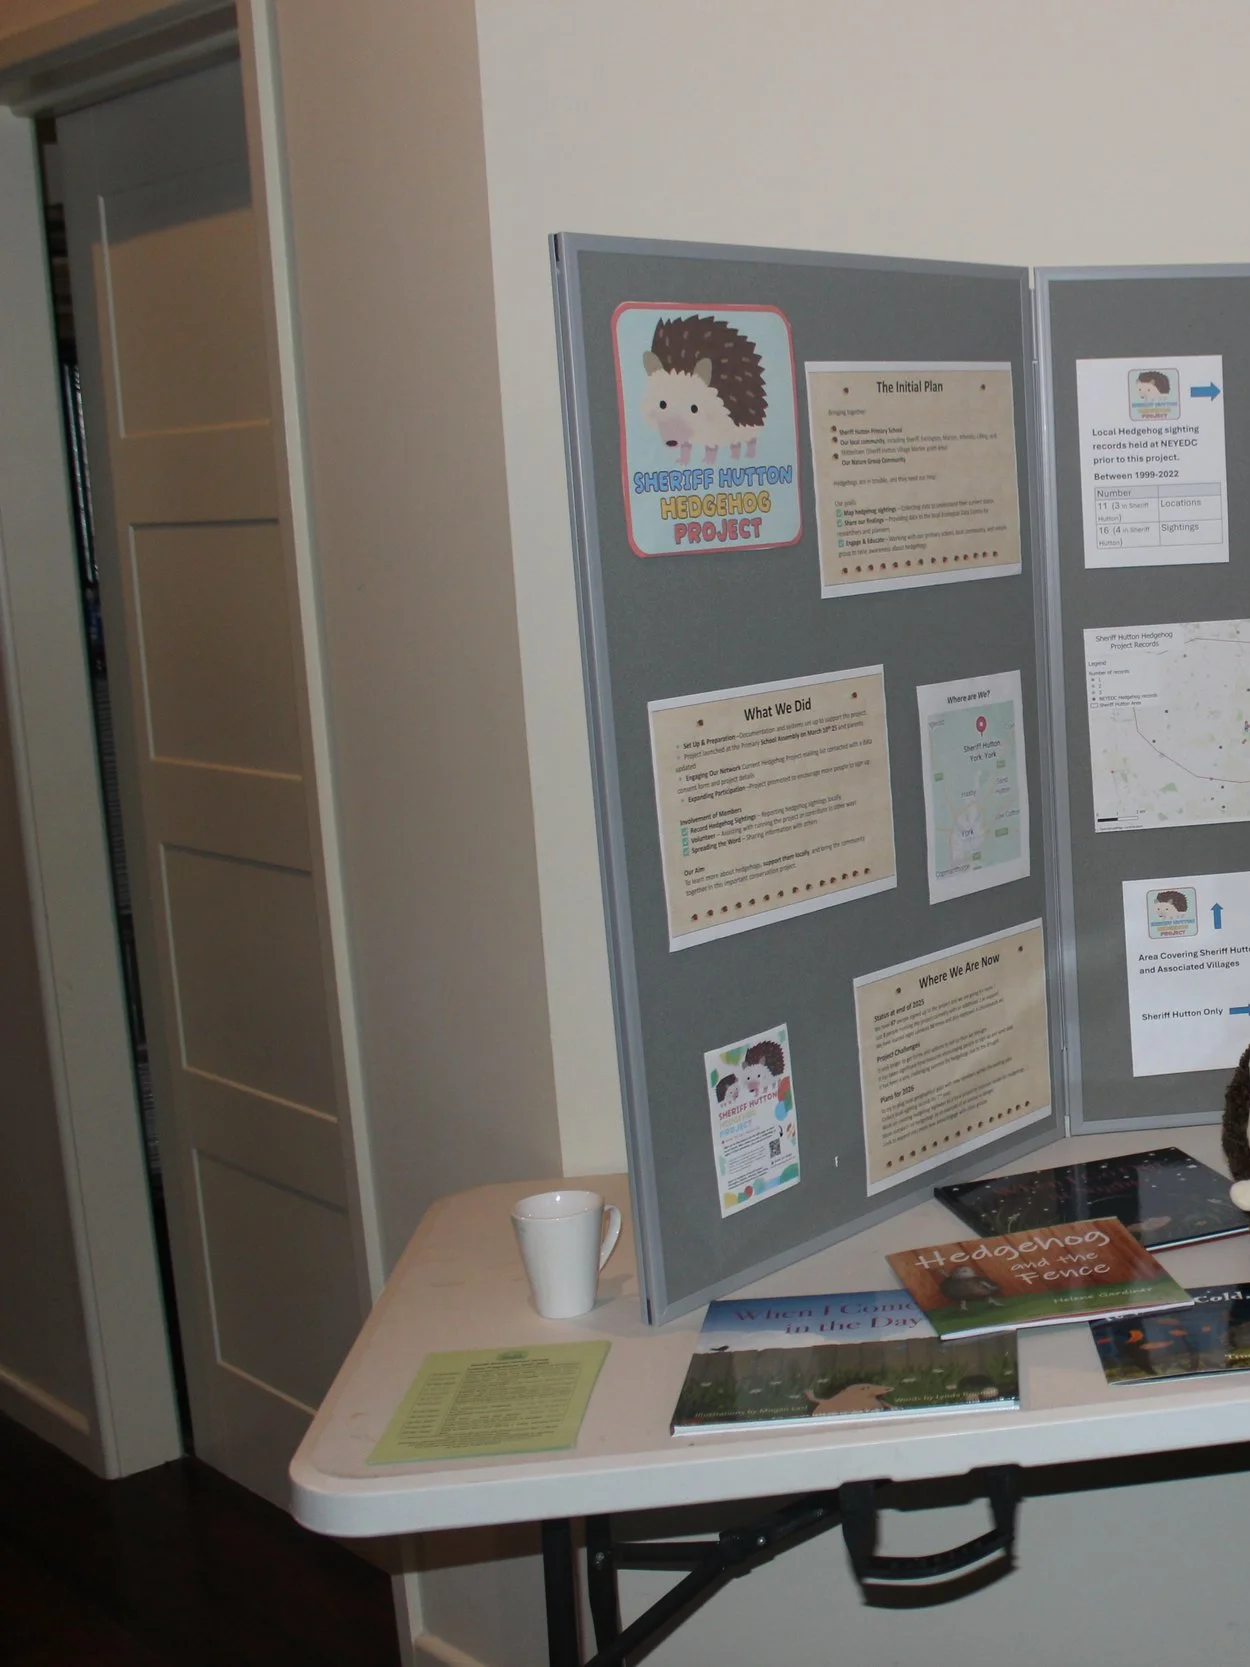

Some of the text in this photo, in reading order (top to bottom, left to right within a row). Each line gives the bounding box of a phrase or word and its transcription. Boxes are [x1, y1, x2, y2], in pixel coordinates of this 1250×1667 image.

[876, 379, 943, 393] The Initial Plan
[1092, 426, 1199, 436] Local Hedgehog sighting
[1093, 442, 1126, 450] records
[1150, 440, 1159, 448] at
[1161, 439, 1198, 447] NEYEDC
[1146, 454, 1179, 463] project.
[633, 464, 792, 494] SHERIFF HUTTON
[1094, 471, 1179, 480] Between 1999-2022
[660, 491, 771, 520] HEDGEHOG
[1161, 499, 1201, 507] Locations
[674, 517, 762, 544] PROJECT
[1161, 523, 1199, 532] Sightings
[1096, 631, 1173, 642] Sheriff Hutton Hedgehog
[1111, 640, 1159, 650] Project Records
[947, 689, 990, 704] Where are We?
[743, 697, 811, 721] What We Did
[1161, 951, 1198, 960] Covering
[1200, 947, 1228, 956] Sheriff
[918, 951, 999, 989] Where We Are Now
[1157, 963, 1204, 973] Associated
[1207, 960, 1239, 969] Villages
[1142, 1007, 1223, 1021] Sheriff Hutton Only
[718, 1092, 778, 1120] SHERIFF HUTTON
[915, 1230, 1110, 1270] Hedgehog
[1010, 1252, 1099, 1272] and the
[1015, 1262, 1110, 1285] Fence
[734, 1301, 918, 1321] When I Come
[786, 1316, 922, 1334] in the Day
